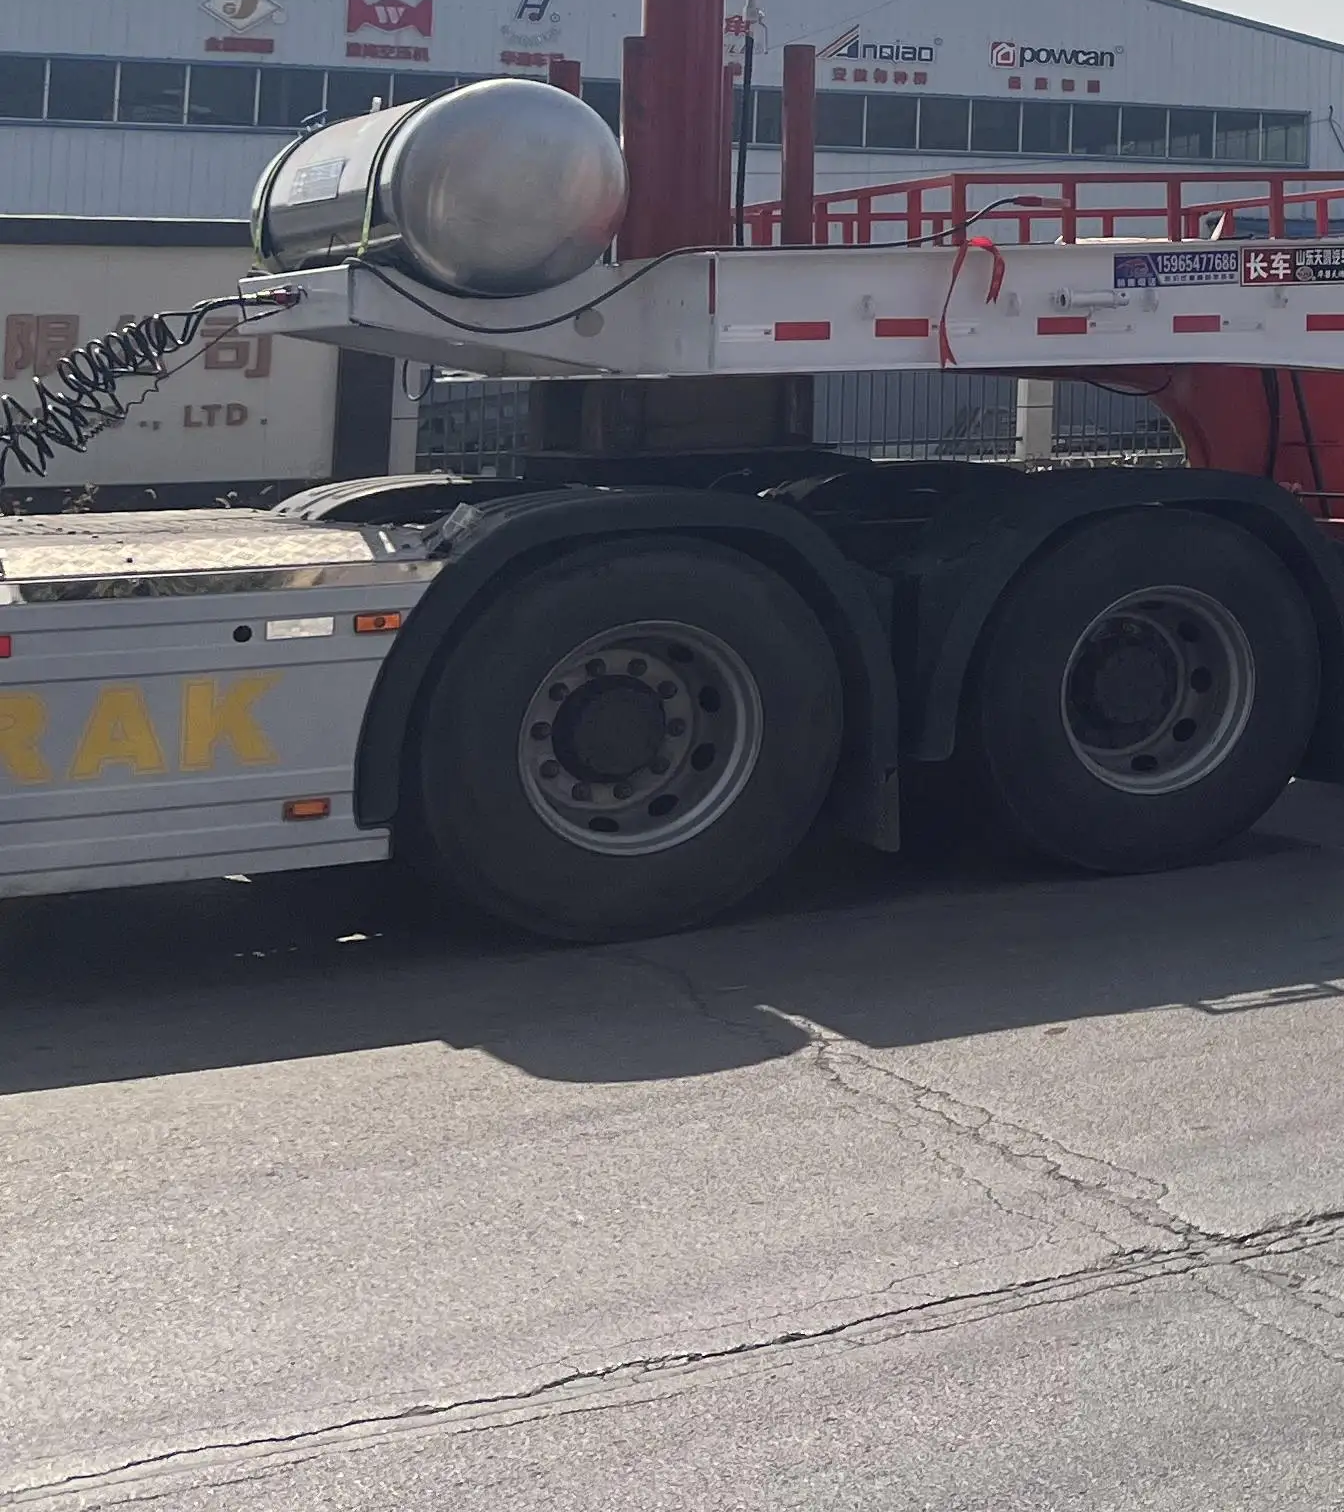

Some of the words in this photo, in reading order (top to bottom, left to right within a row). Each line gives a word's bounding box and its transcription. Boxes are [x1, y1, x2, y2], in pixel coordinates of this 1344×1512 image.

[1019, 45, 1116, 68] powcan
[1156, 251, 1237, 274] 15965477686
[1245, 250, 1292, 280] 长车
